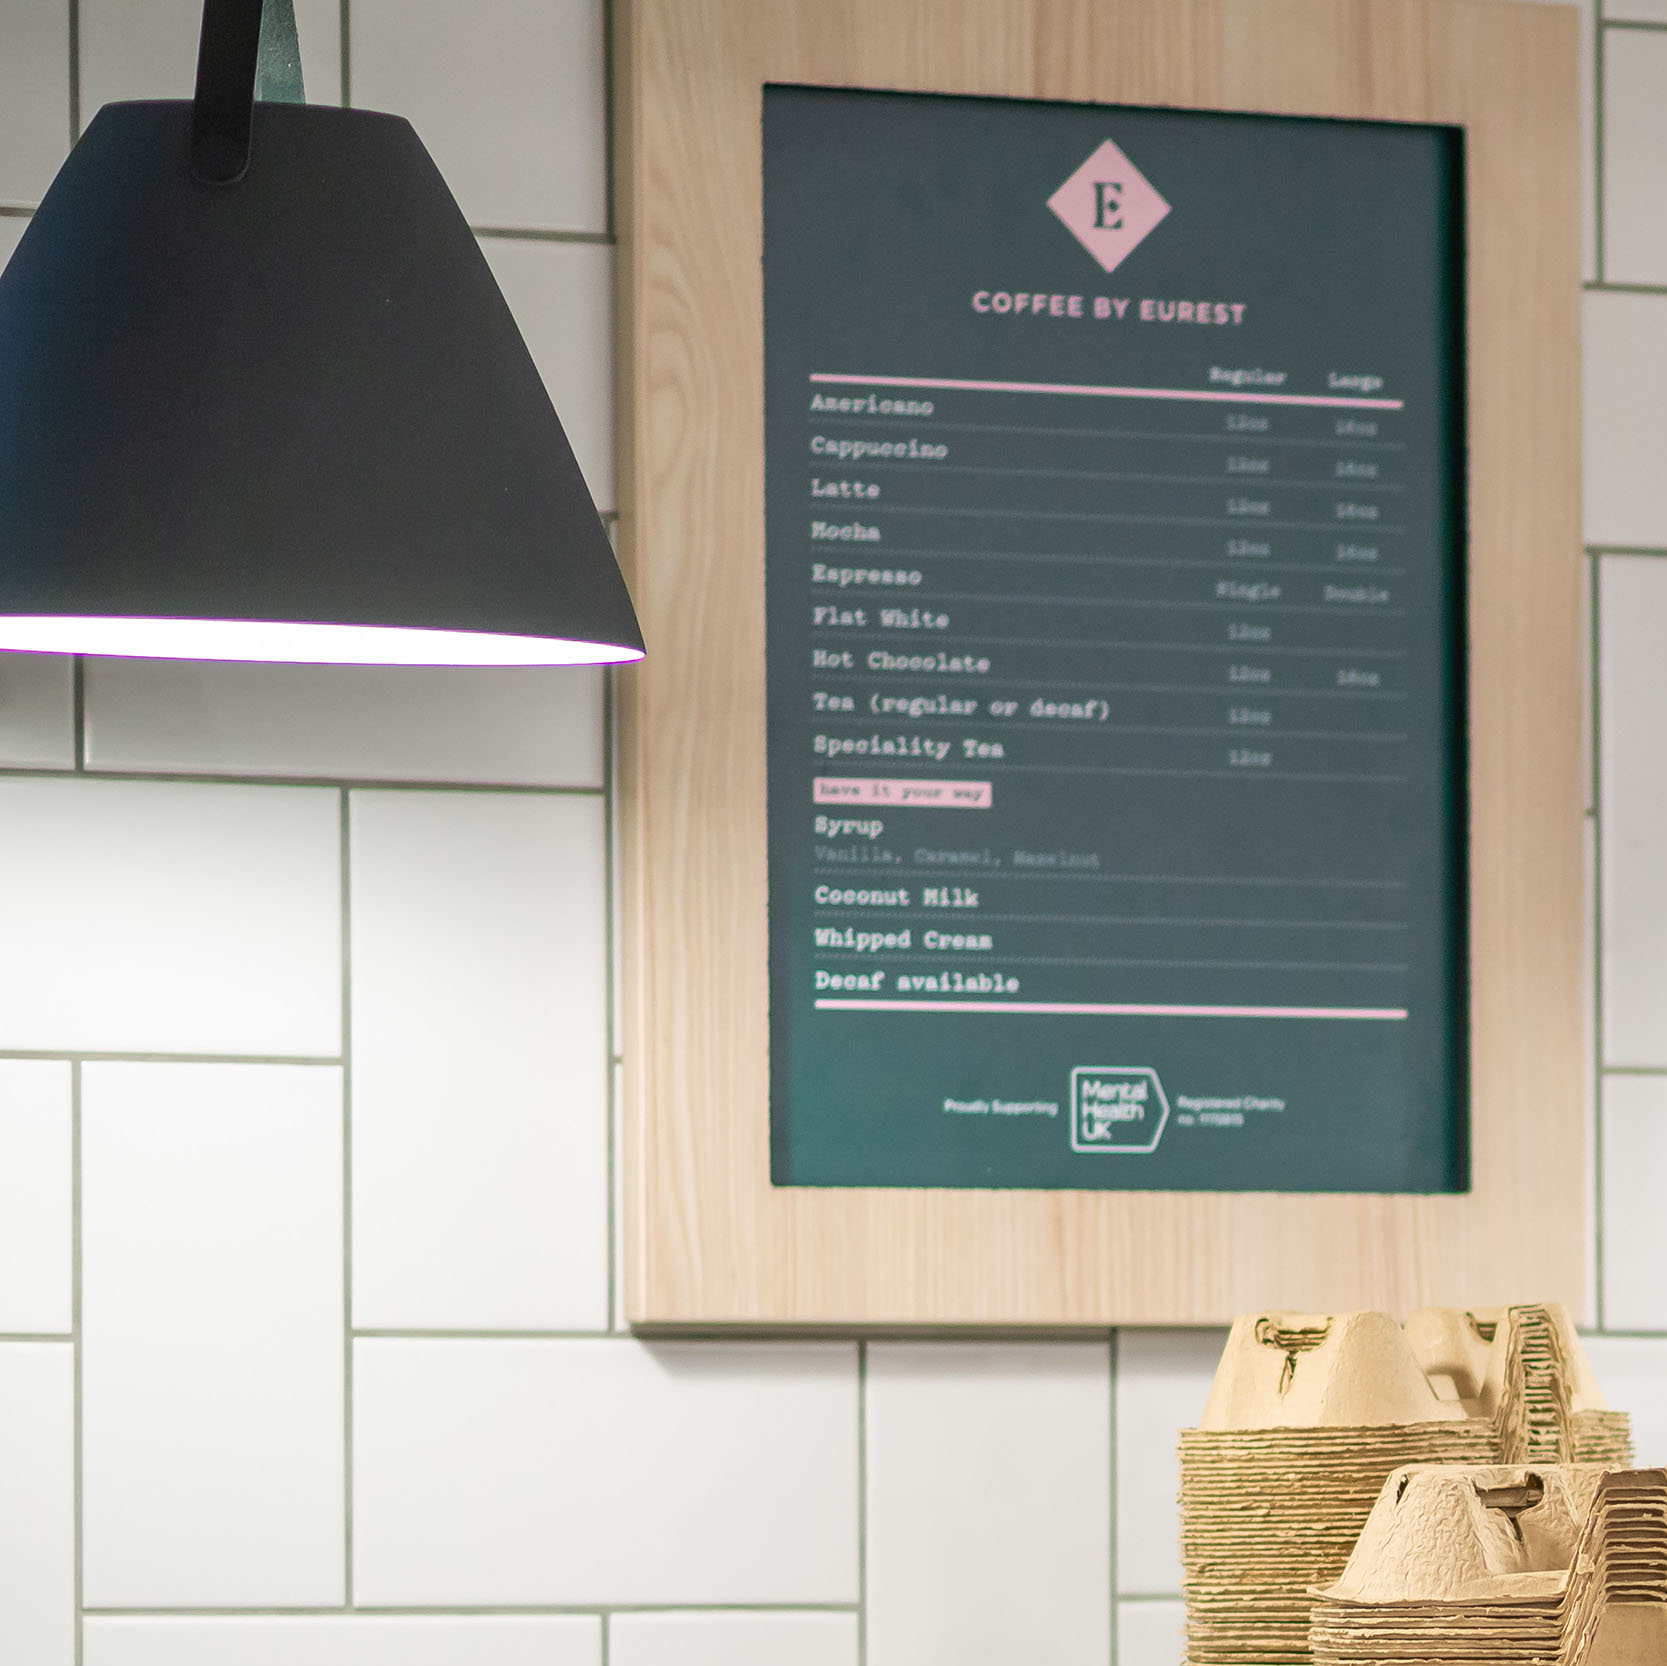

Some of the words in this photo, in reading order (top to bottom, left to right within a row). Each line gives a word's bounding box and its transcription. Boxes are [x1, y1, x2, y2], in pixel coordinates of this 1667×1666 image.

[1093, 182, 1122, 229] E
[973, 291, 1083, 318] COFFEE
[1093, 296, 1129, 319] BY
[1140, 299, 1246, 325] EUREST
[810, 394, 934, 416] Americano
[811, 436, 948, 460] Cappuccino
[811, 478, 880, 499] Latte
[811, 521, 880, 542] Mocha
[812, 563, 923, 587] Espresso
[813, 606, 867, 626] Flat
[880, 609, 949, 629] White
[813, 650, 853, 668] Hot
[868, 651, 991, 673] Chocolate
[814, 692, 854, 711] Tea
[871, 693, 978, 718] (regular
[989, 699, 1018, 715] or
[1030, 698, 1110, 721] decaf)
[814, 735, 951, 760] Speciality
[963, 738, 1005, 758] Tea
[815, 815, 883, 840] Syrup
[814, 884, 910, 906] Coconut
[923, 887, 979, 907] Milk
[815, 927, 911, 952] Whipped
[924, 930, 993, 950] Cream
[815, 970, 885, 990] Decaf
[897, 971, 1020, 993] available
[1082, 1080, 1148, 1100] Mental
[1082, 1102, 1144, 1121] Health
[1082, 1121, 1112, 1140] UK
